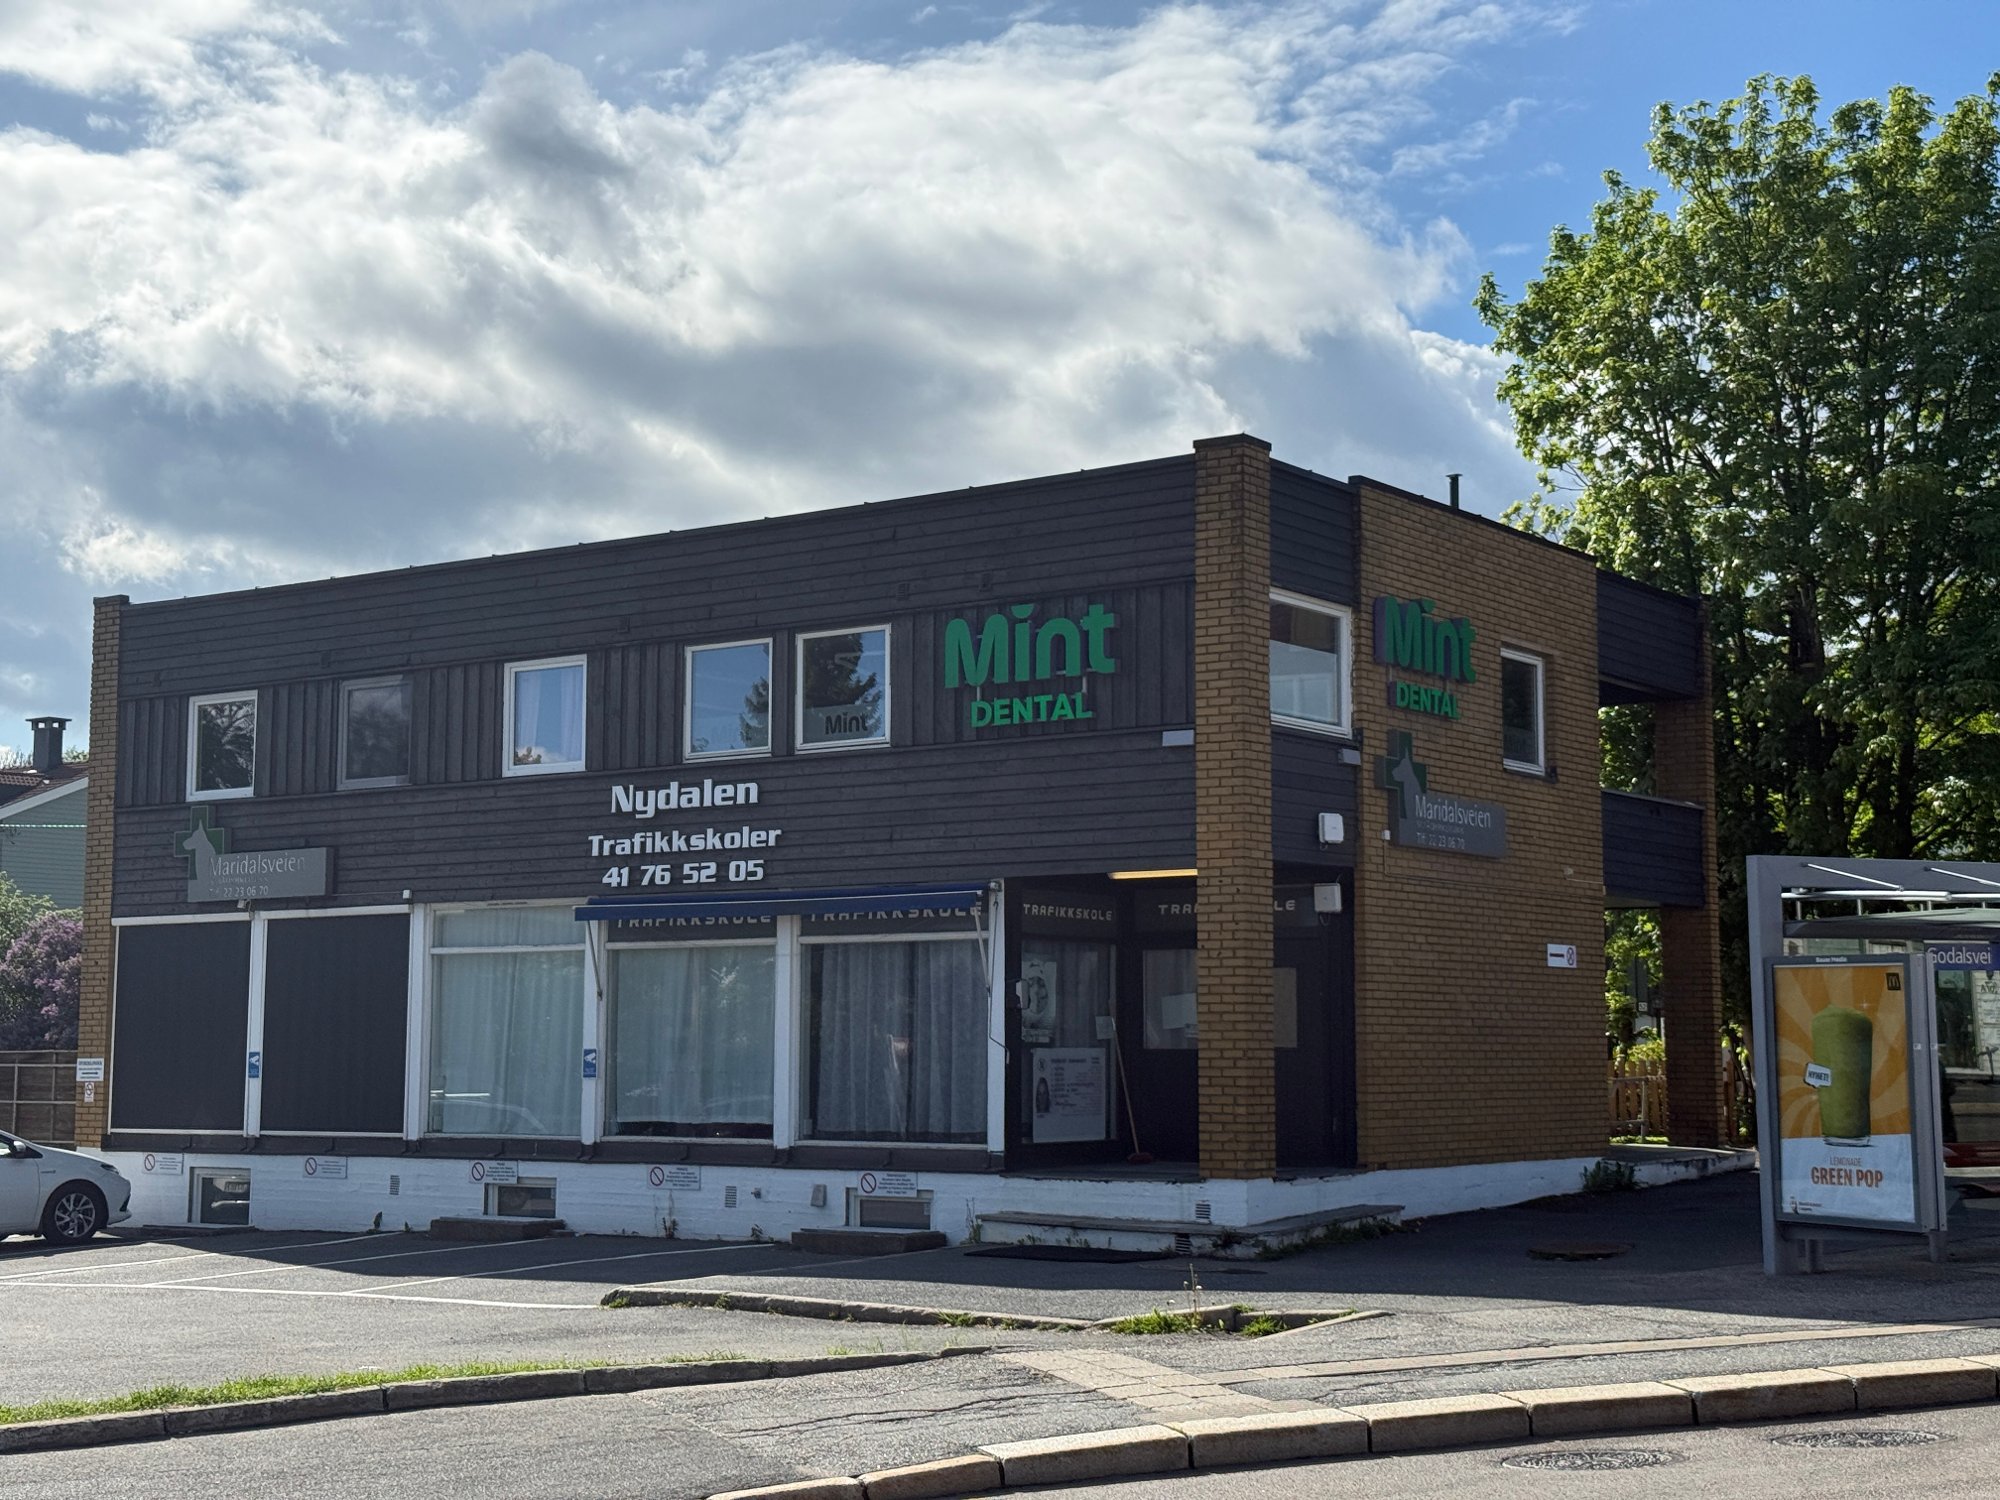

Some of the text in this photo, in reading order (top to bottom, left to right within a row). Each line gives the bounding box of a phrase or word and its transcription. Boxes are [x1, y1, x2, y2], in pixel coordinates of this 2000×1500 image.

[944, 603, 1116, 689] Mint
[1380, 596, 1477, 684] Mint
[970, 692, 1094, 728] DENTAL
[1394, 680, 1462, 720] DENTAL
[825, 711, 868, 735] Mint
[610, 778, 759, 820] Nydalen
[1415, 794, 1491, 829] Maridalsveien
[588, 826, 782, 857] Trafikkskoler
[210, 852, 305, 876] Maridalsveien
[602, 859, 765, 888] 41 76 52 05
[223, 887, 233, 898] 22
[258, 884, 269, 896] 70
[1023, 903, 1113, 921] TRAFIKKSKOLE
[1829, 1156, 1862, 1167] LEMONADE
[1811, 1166, 1883, 1188] GREEN POP
